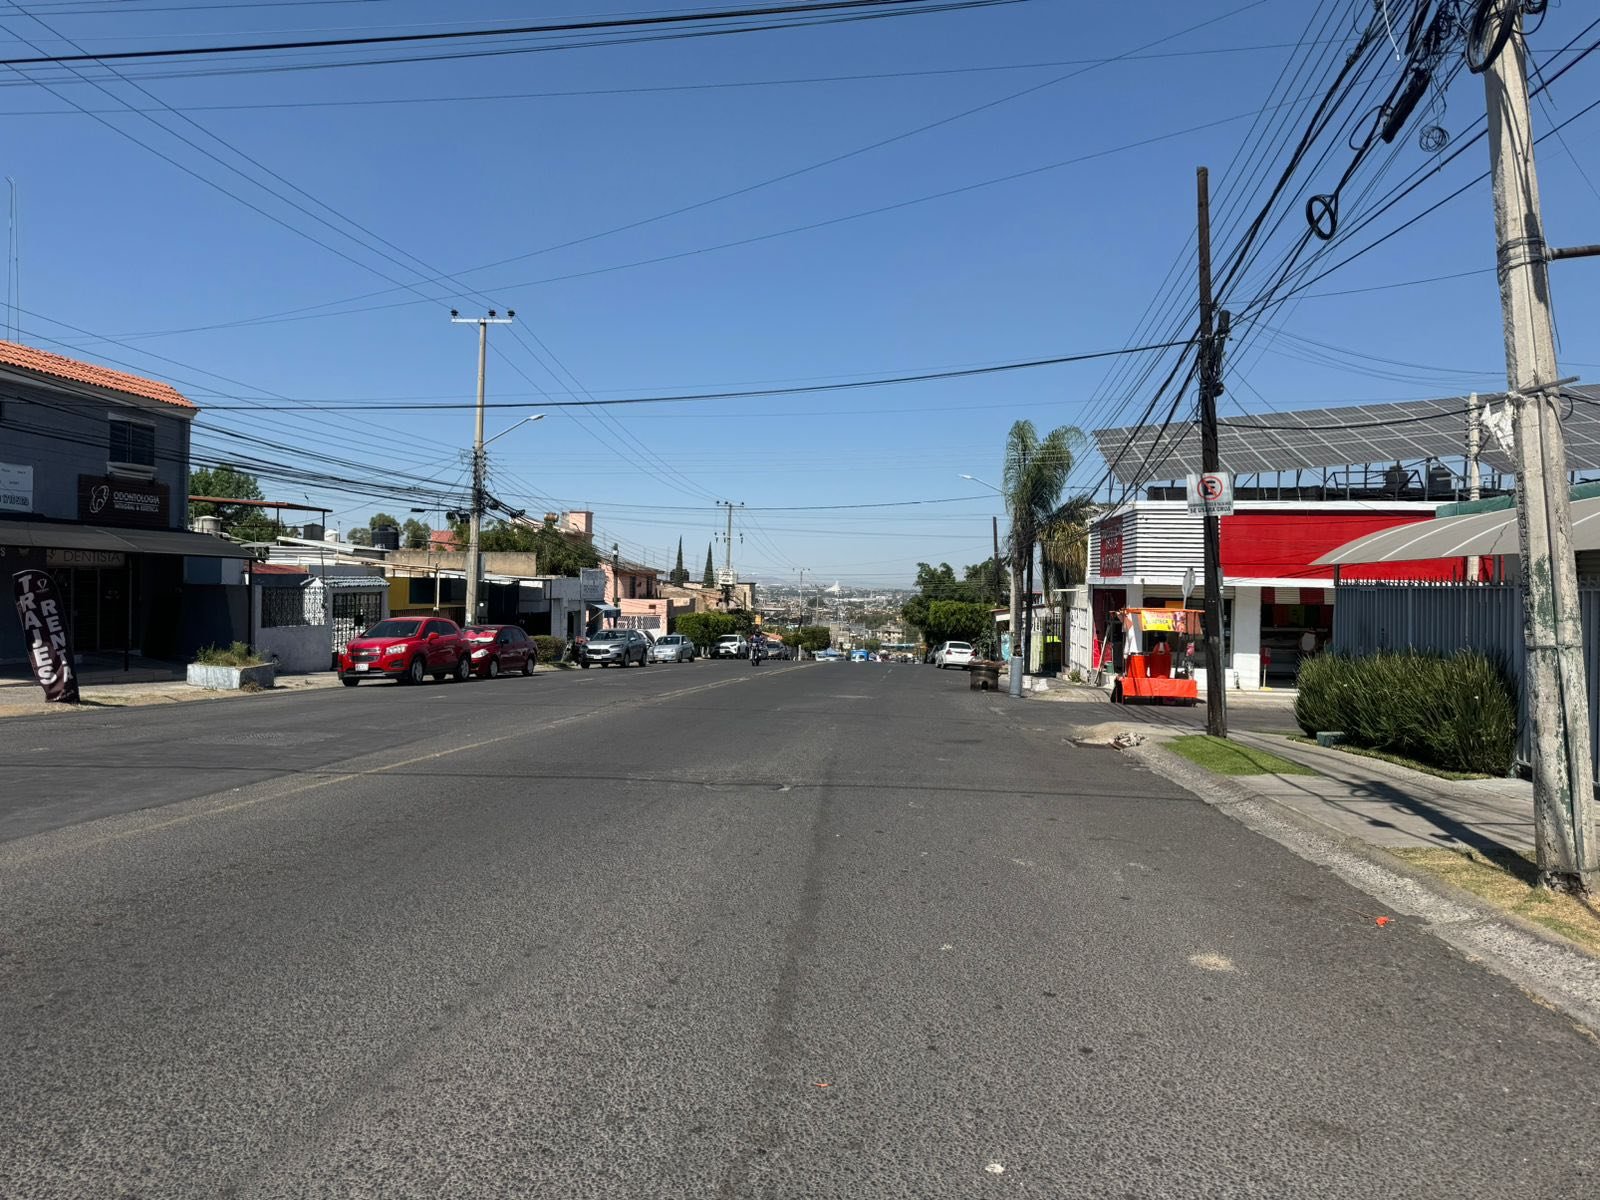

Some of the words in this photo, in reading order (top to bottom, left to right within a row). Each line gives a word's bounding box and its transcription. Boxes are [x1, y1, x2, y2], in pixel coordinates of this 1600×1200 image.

[63, 551, 121, 562] DENTISTA
[18, 574, 57, 685] TRAJES
[41, 599, 73, 682] RENTA
